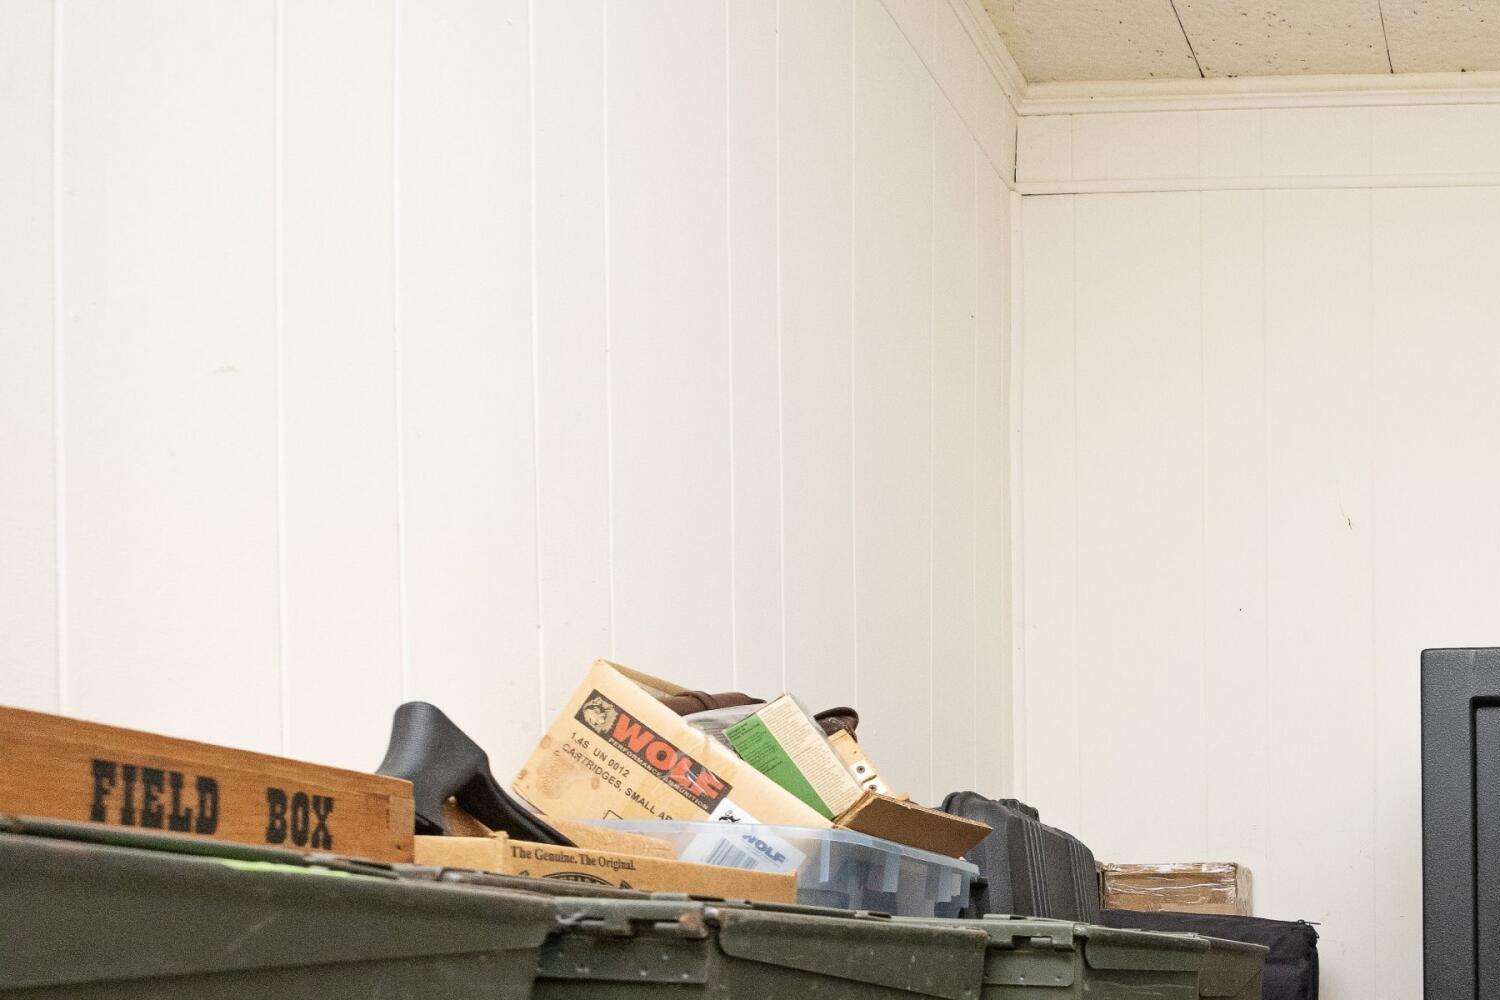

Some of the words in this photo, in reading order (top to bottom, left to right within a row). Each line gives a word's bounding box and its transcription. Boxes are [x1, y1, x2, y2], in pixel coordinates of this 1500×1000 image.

[562, 743, 622, 792] CARTRIDGES,
[625, 788, 655, 815] SMALL
[570, 732, 590, 749] 1.4S
[592, 748, 606, 762] UN
[607, 758, 631, 778] 0012
[612, 713, 725, 799] WOLF
[89, 758, 220, 836] FIELD
[266, 786, 335, 850] BOX
[510, 846, 532, 859] The
[534, 848, 577, 865] Genuine.
[579, 853, 596, 866] The
[598, 856, 636, 871] Original.
